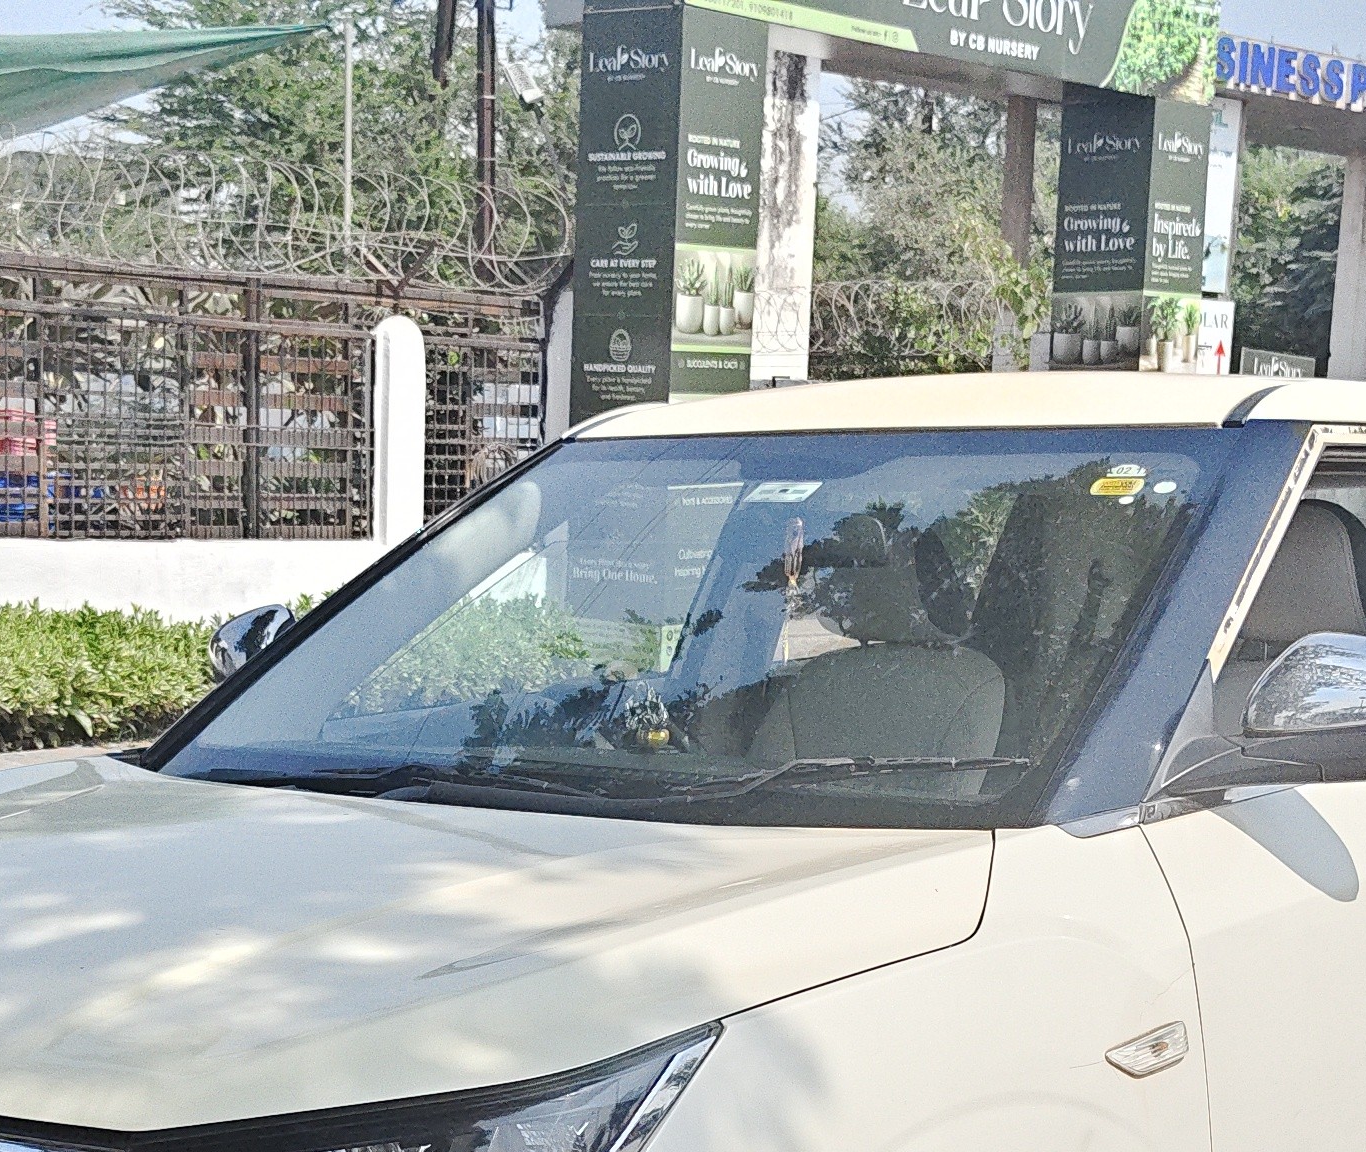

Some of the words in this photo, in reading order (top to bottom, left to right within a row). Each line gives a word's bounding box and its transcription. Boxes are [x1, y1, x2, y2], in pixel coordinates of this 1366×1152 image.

[949, 28, 967, 47] BY
[968, 34, 985, 51] CB
[987, 36, 1041, 61] NURSERY
[588, 44, 629, 73] Leaf
[630, 48, 669, 73] Story
[690, 46, 725, 73] Leaf
[726, 52, 759, 83] Story
[1067, 132, 1103, 155] Leaf
[1104, 134, 1141, 154] Story
[1158, 131, 1181, 153] Leaf
[1181, 135, 1205, 160] Story
[687, 149, 740, 177] Growing
[687, 173, 719, 197] with
[720, 177, 752, 200] Love
[1063, 215, 1121, 233] Growing
[1153, 213, 1196, 240] Inspired
[1063, 234, 1098, 253] with
[1100, 234, 1135, 252] Love
[1152, 237, 1167, 262] by
[1168, 237, 1191, 260] Life.
[590, 258, 608, 268] CARE
[609, 258, 619, 268] AT
[583, 363, 627, 373] HANDPICKED
[627, 364, 656, 374] QUALITY
[572, 566, 600, 582] Bring
[602, 567, 623, 581] One
[624, 569, 659, 585] Home.
